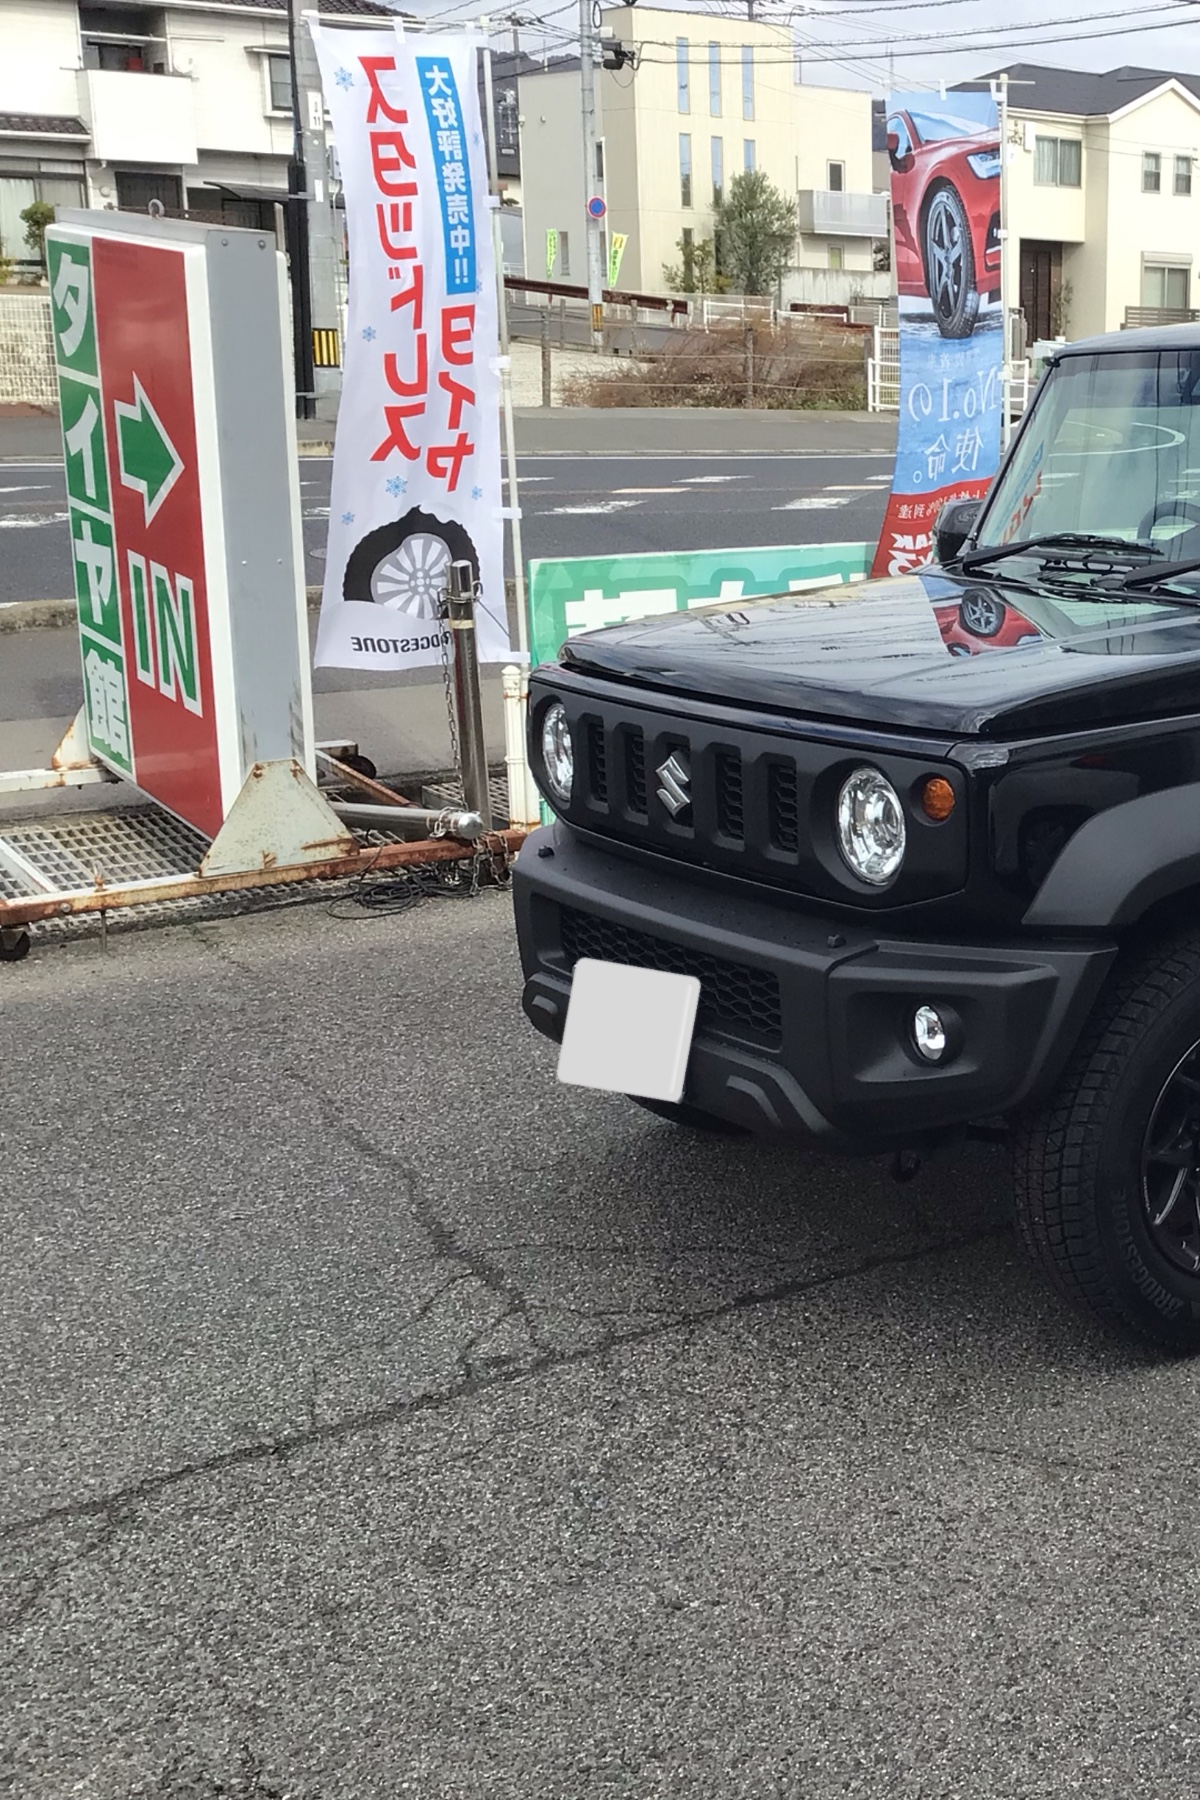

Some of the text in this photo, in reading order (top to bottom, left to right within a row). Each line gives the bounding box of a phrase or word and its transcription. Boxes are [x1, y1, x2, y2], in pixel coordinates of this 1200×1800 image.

[53, 250, 130, 762] タイヤ館
[127, 549, 203, 718] IN
